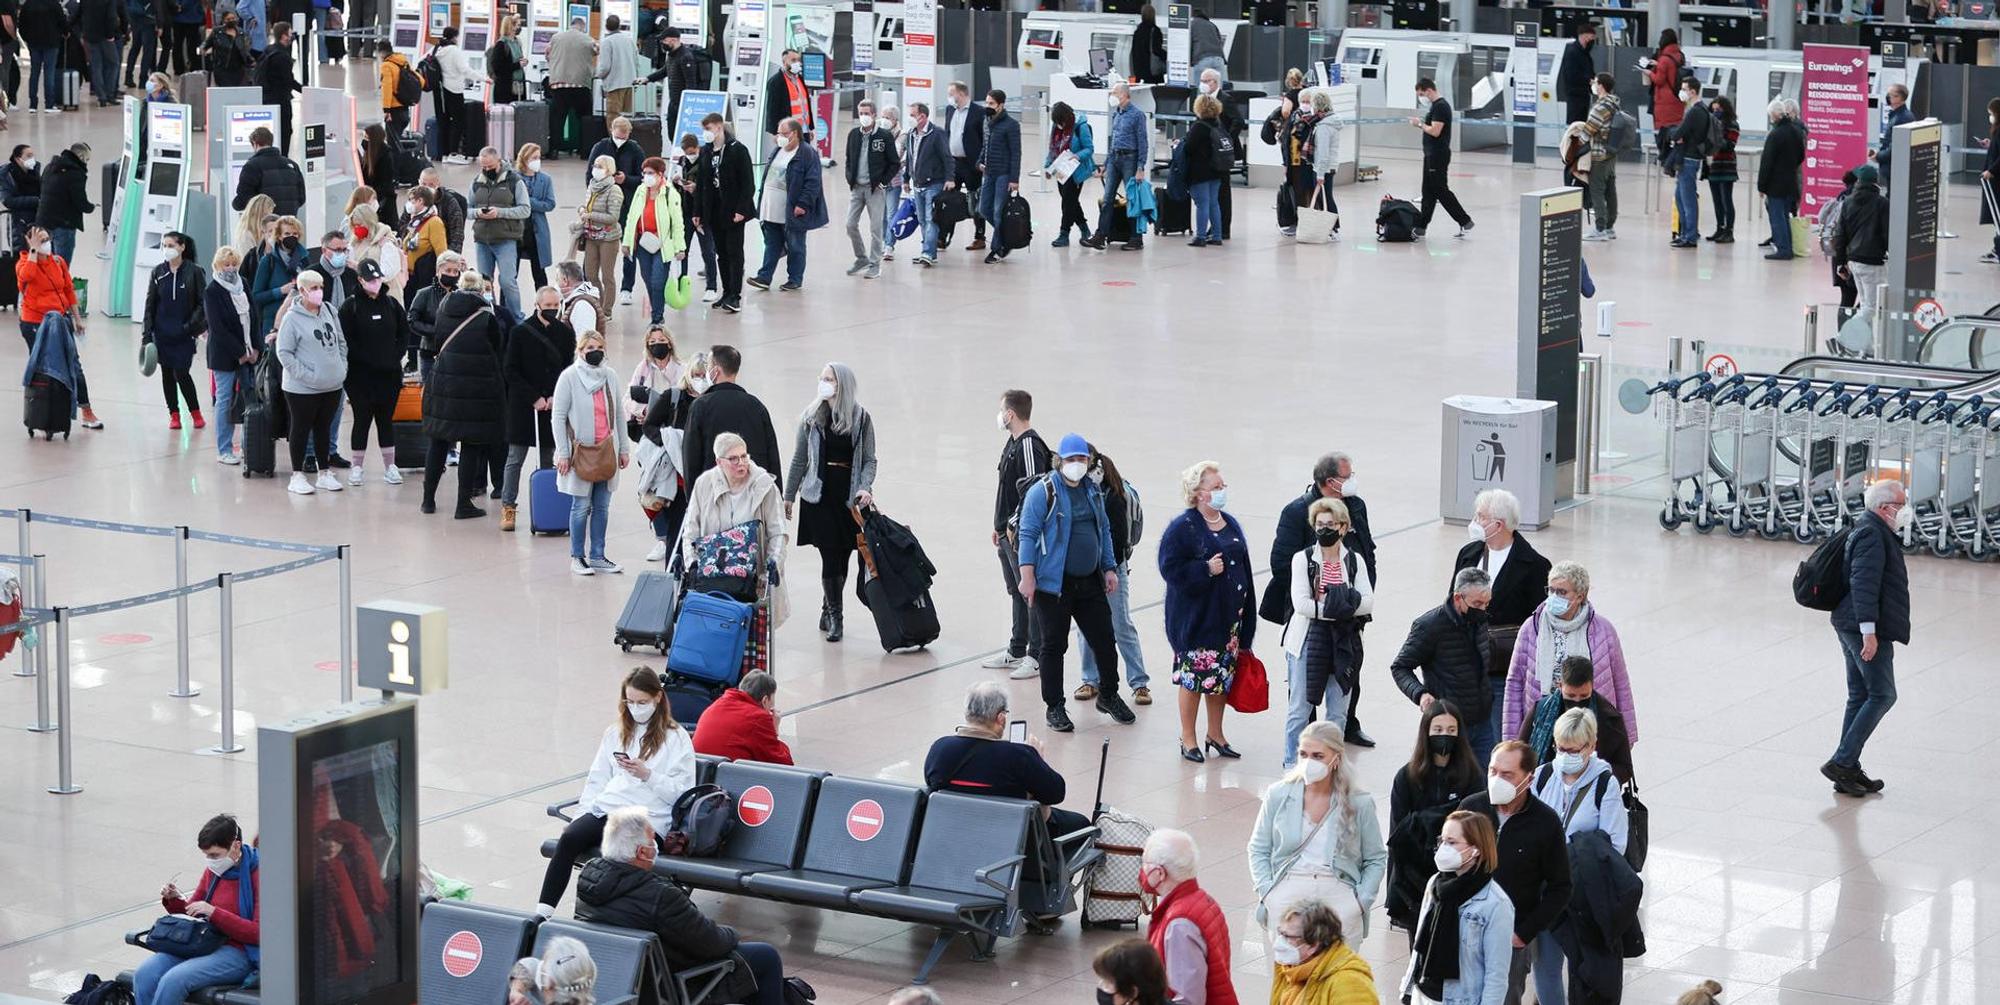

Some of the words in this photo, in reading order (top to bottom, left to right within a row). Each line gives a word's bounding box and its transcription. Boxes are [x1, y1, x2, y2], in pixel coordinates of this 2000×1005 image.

[1808, 61, 1853, 75] Eurowings
[1808, 82, 1858, 92] ERFORDERLICHE
[1808, 91, 1864, 101] REISEDOKUMENTE
[388, 620, 414, 684] i
